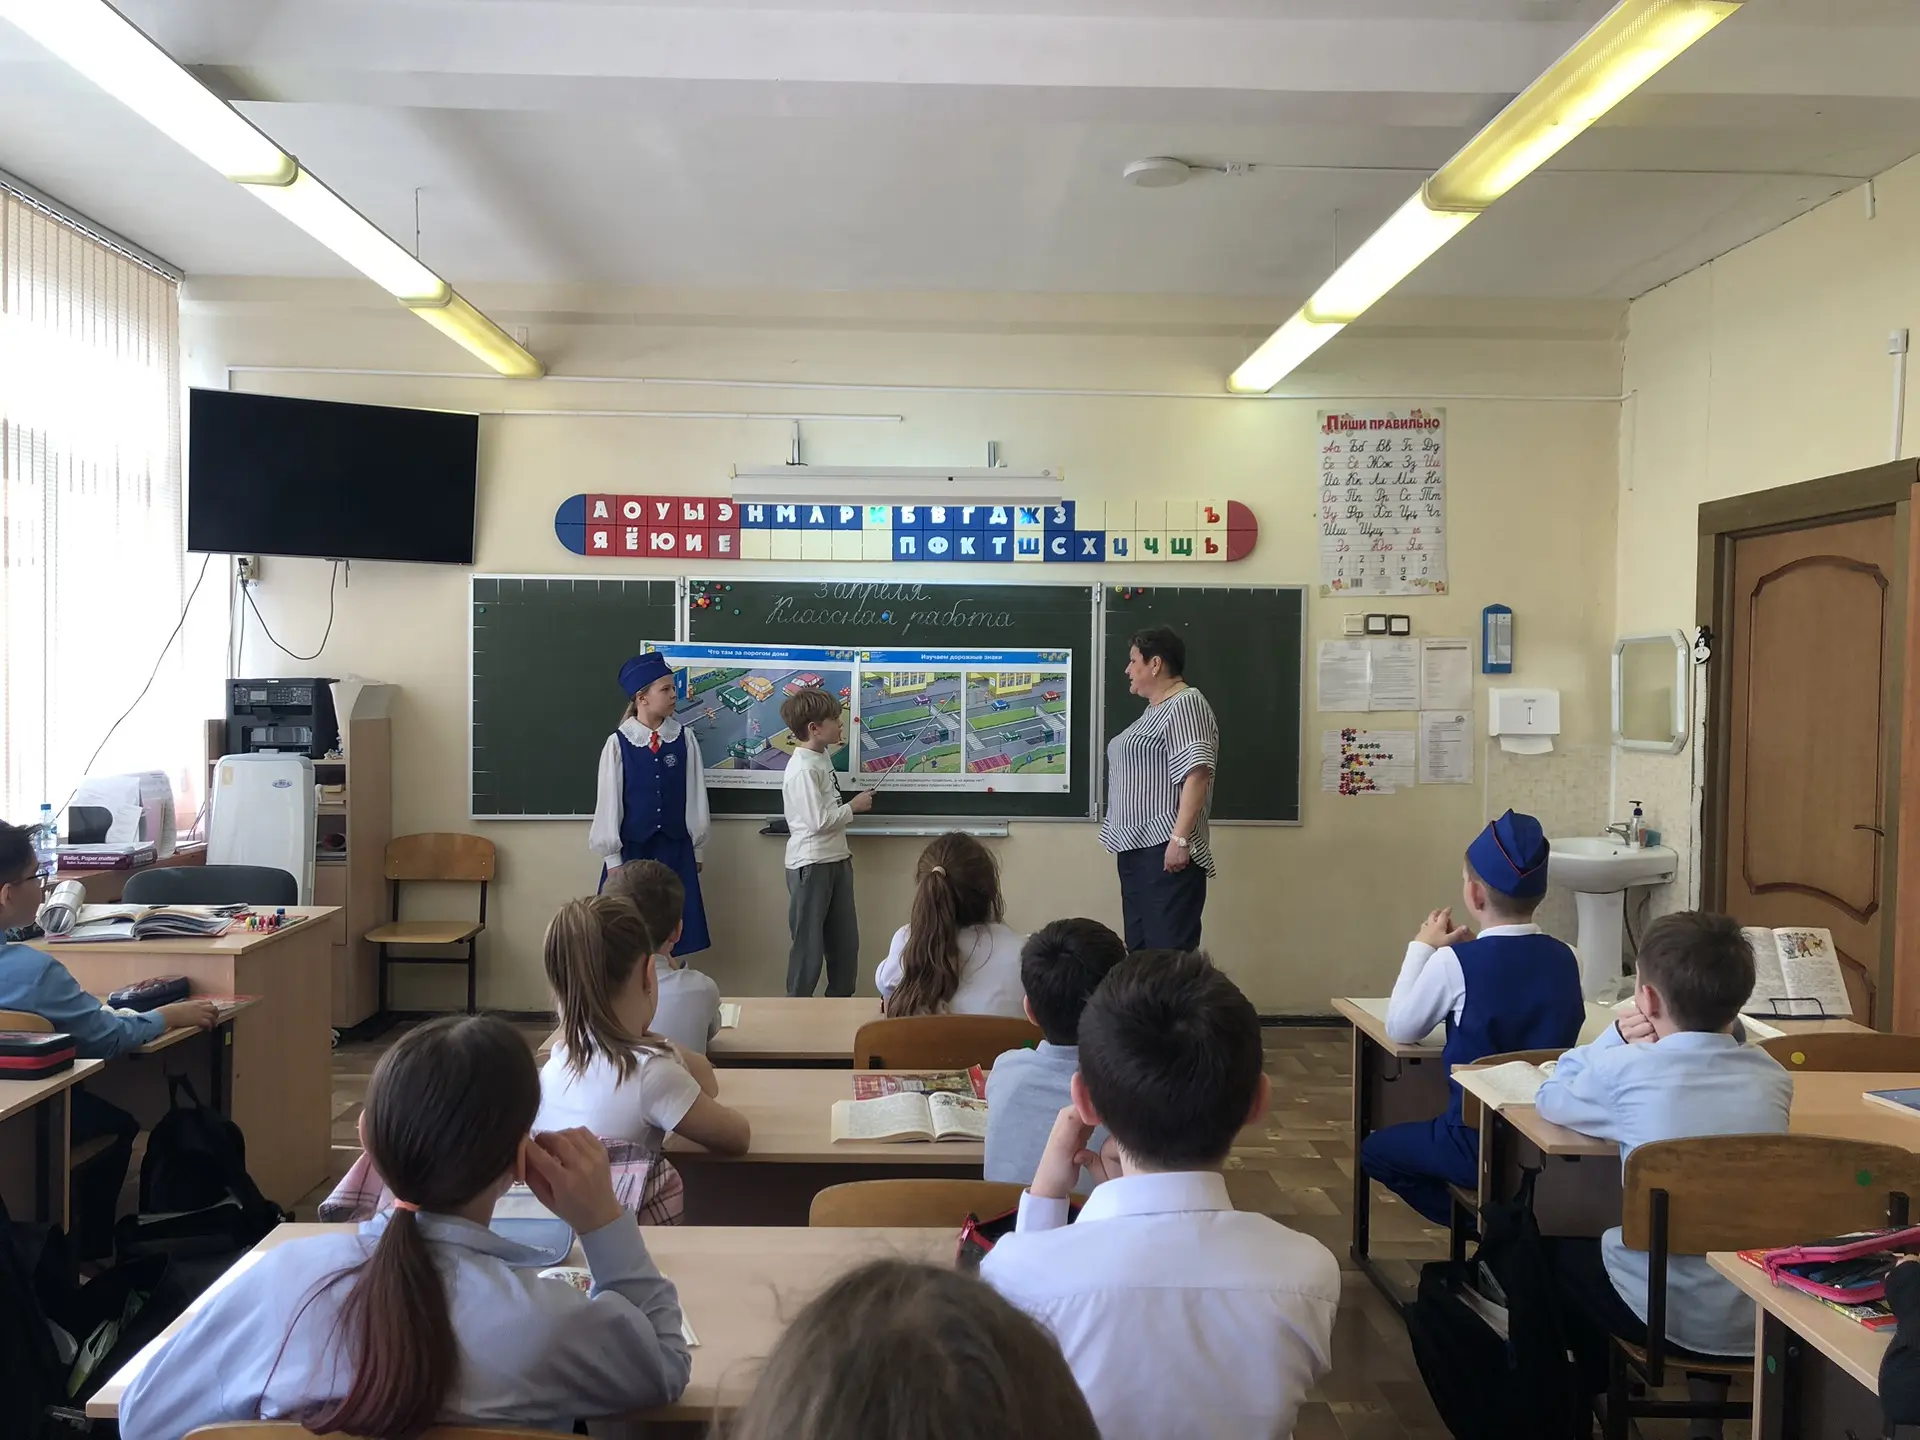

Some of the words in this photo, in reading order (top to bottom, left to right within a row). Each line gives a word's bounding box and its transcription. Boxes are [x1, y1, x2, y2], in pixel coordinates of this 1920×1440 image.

[1326, 415, 1366, 430] ПИШИ
[1369, 418, 1440, 430] ПРАВИЛЬНО
[593, 501, 609, 518] А
[623, 501, 641, 519] О
[656, 503, 670, 520] У
[684, 503, 704, 520] Ы
[717, 504, 733, 521] Э
[748, 505, 764, 522] Н
[776, 506, 796, 523] М
[808, 506, 825, 524] Л
[840, 505, 854, 524] Р
[901, 506, 916, 525] Б
[931, 506, 946, 525] В
[962, 506, 975, 524] Г
[989, 506, 1008, 525] Д
[1019, 506, 1040, 525] Ж
[1053, 506, 1066, 523] З
[1204, 506, 1221, 523] Ъ
[593, 532, 608, 548] Я
[626, 527, 638, 550] Ё
[650, 533, 675, 550] Ю
[686, 534, 702, 551] И
[718, 535, 731, 552] Е
[900, 536, 916, 555] П
[928, 536, 948, 555] Ф
[961, 537, 976, 555] К
[992, 537, 1006, 554] Т
[1018, 538, 1040, 555] Ш
[1052, 537, 1066, 555] С
[1082, 537, 1097, 555] Х
[1114, 537, 1129, 556] Ц
[1144, 538, 1159, 554] Ч
[1170, 538, 1192, 556] Щ
[1205, 538, 1219, 554] Ь
[814, 583, 828, 599] 3
[766, 595, 899, 626] Классная
[901, 598, 1016, 635] работа
